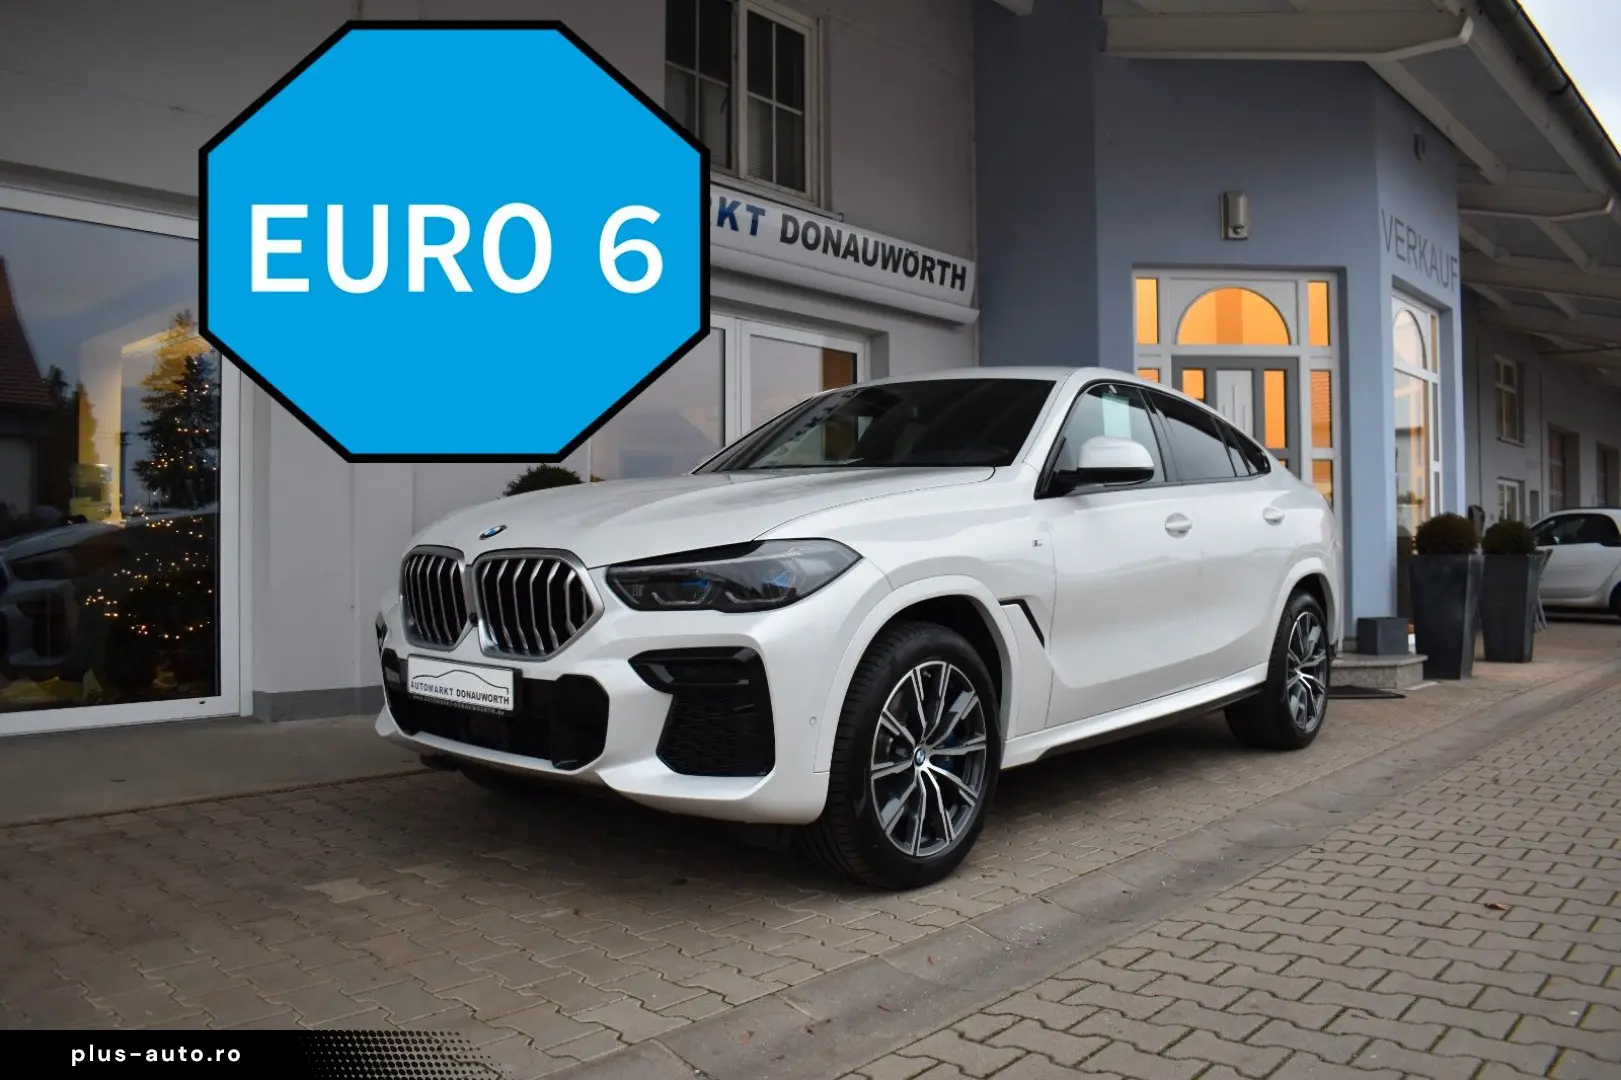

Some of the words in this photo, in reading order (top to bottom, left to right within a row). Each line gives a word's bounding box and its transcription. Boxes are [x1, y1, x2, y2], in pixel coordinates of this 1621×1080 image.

[710, 196, 765, 236] KT
[780, 213, 967, 291] DONAUWÖRTH
[1381, 206, 1458, 292] VERKAUF
[411, 681, 453, 696] AUTOMARKT
